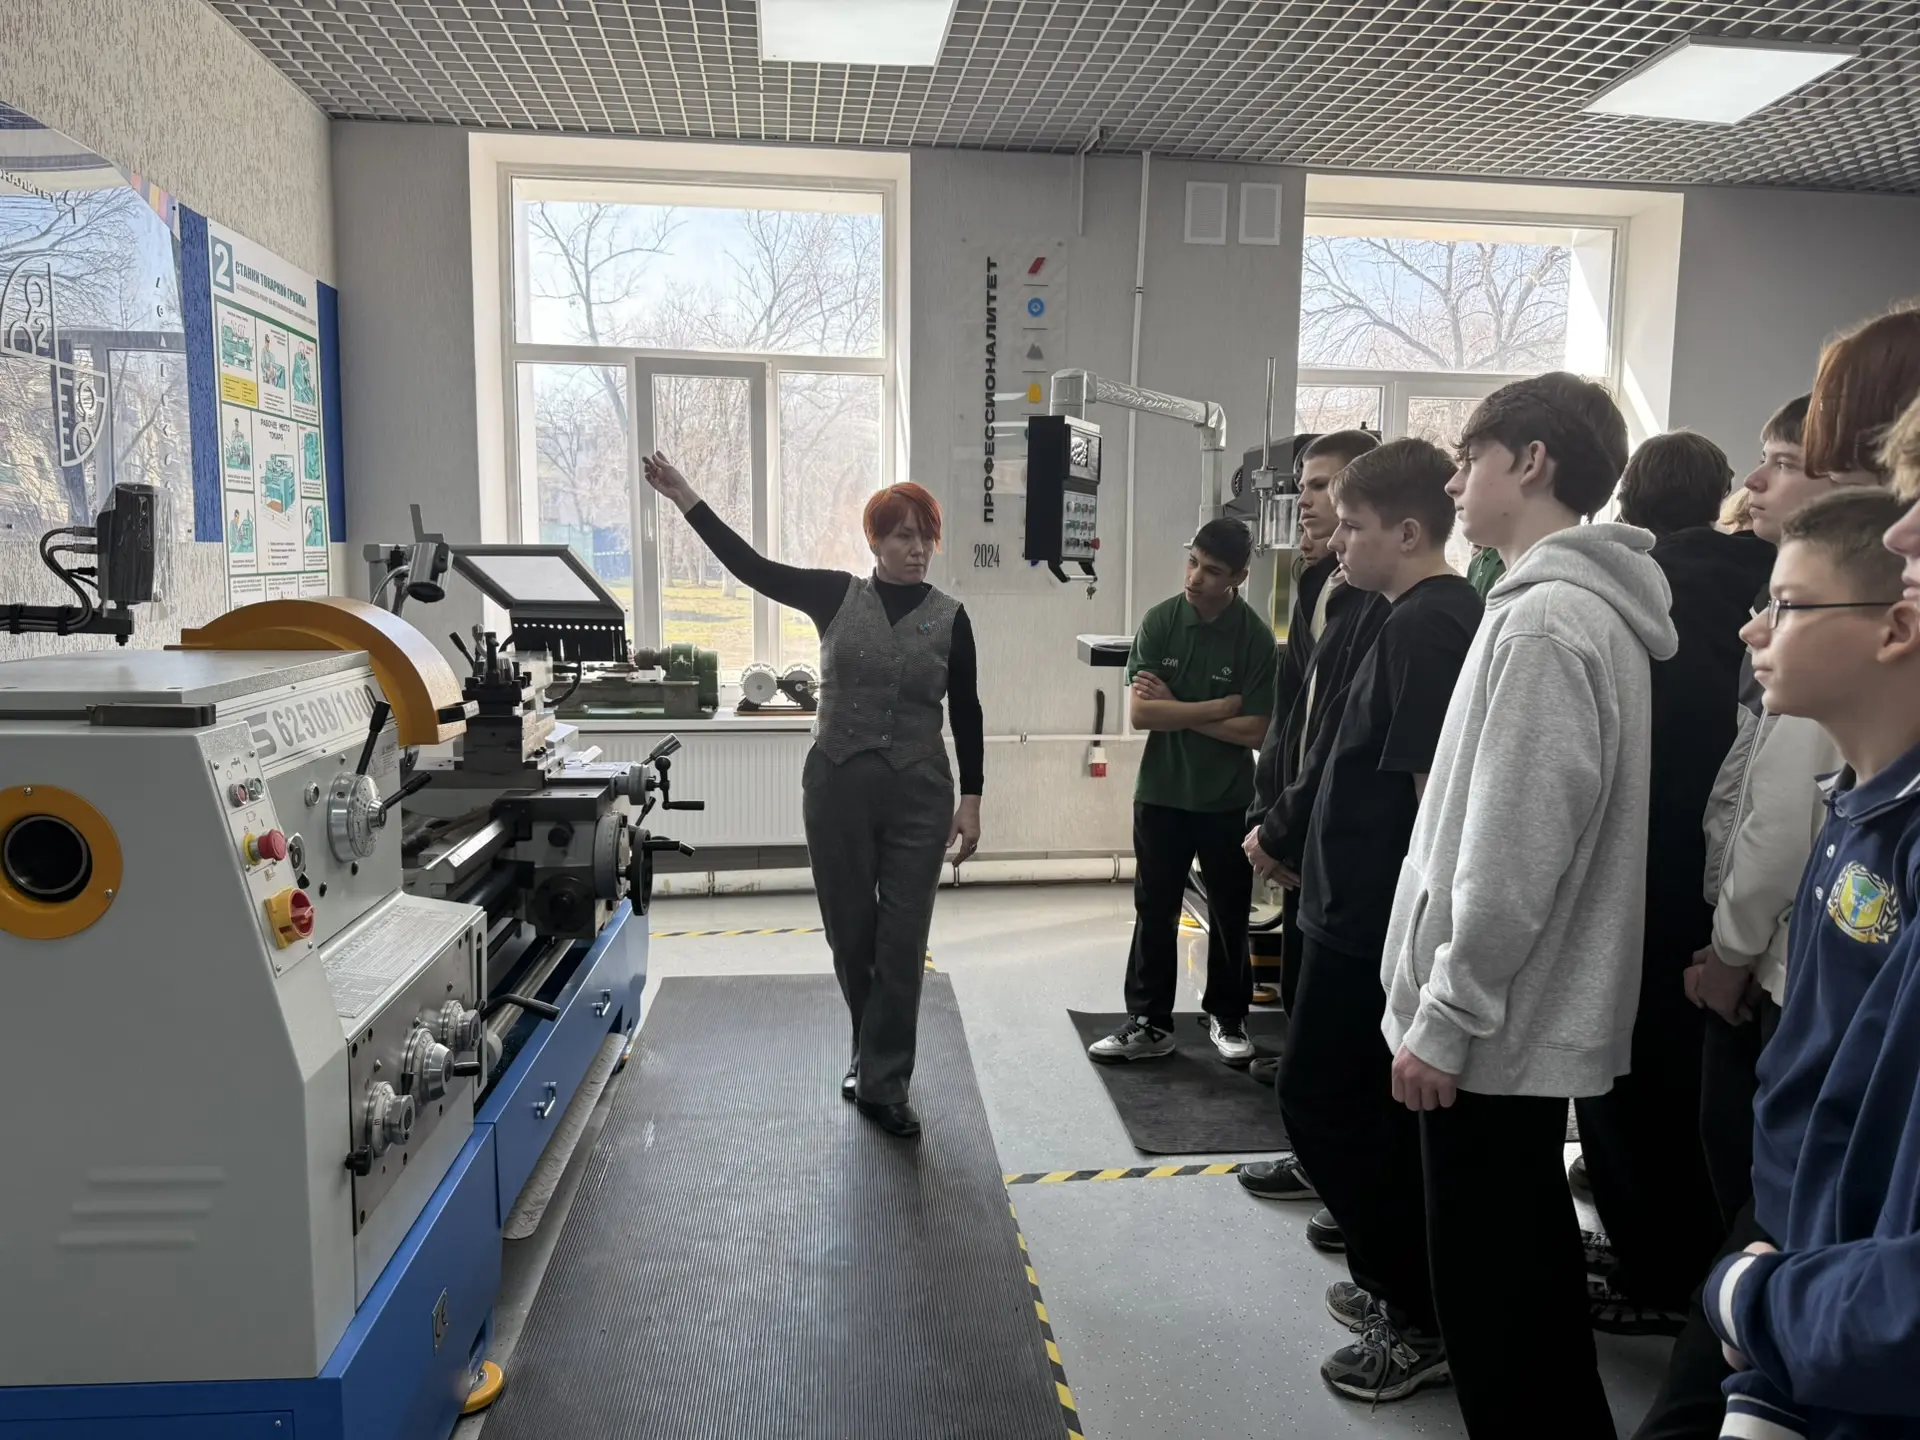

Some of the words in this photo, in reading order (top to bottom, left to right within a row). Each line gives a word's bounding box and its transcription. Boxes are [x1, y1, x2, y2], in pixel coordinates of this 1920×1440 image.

[214, 242, 231, 287] 2
[235, 260, 260, 285] СТАНКИ
[983, 256, 998, 523] ПРОФЕССИОНАЛИТЕТ
[973, 543, 1000, 569] 2024
